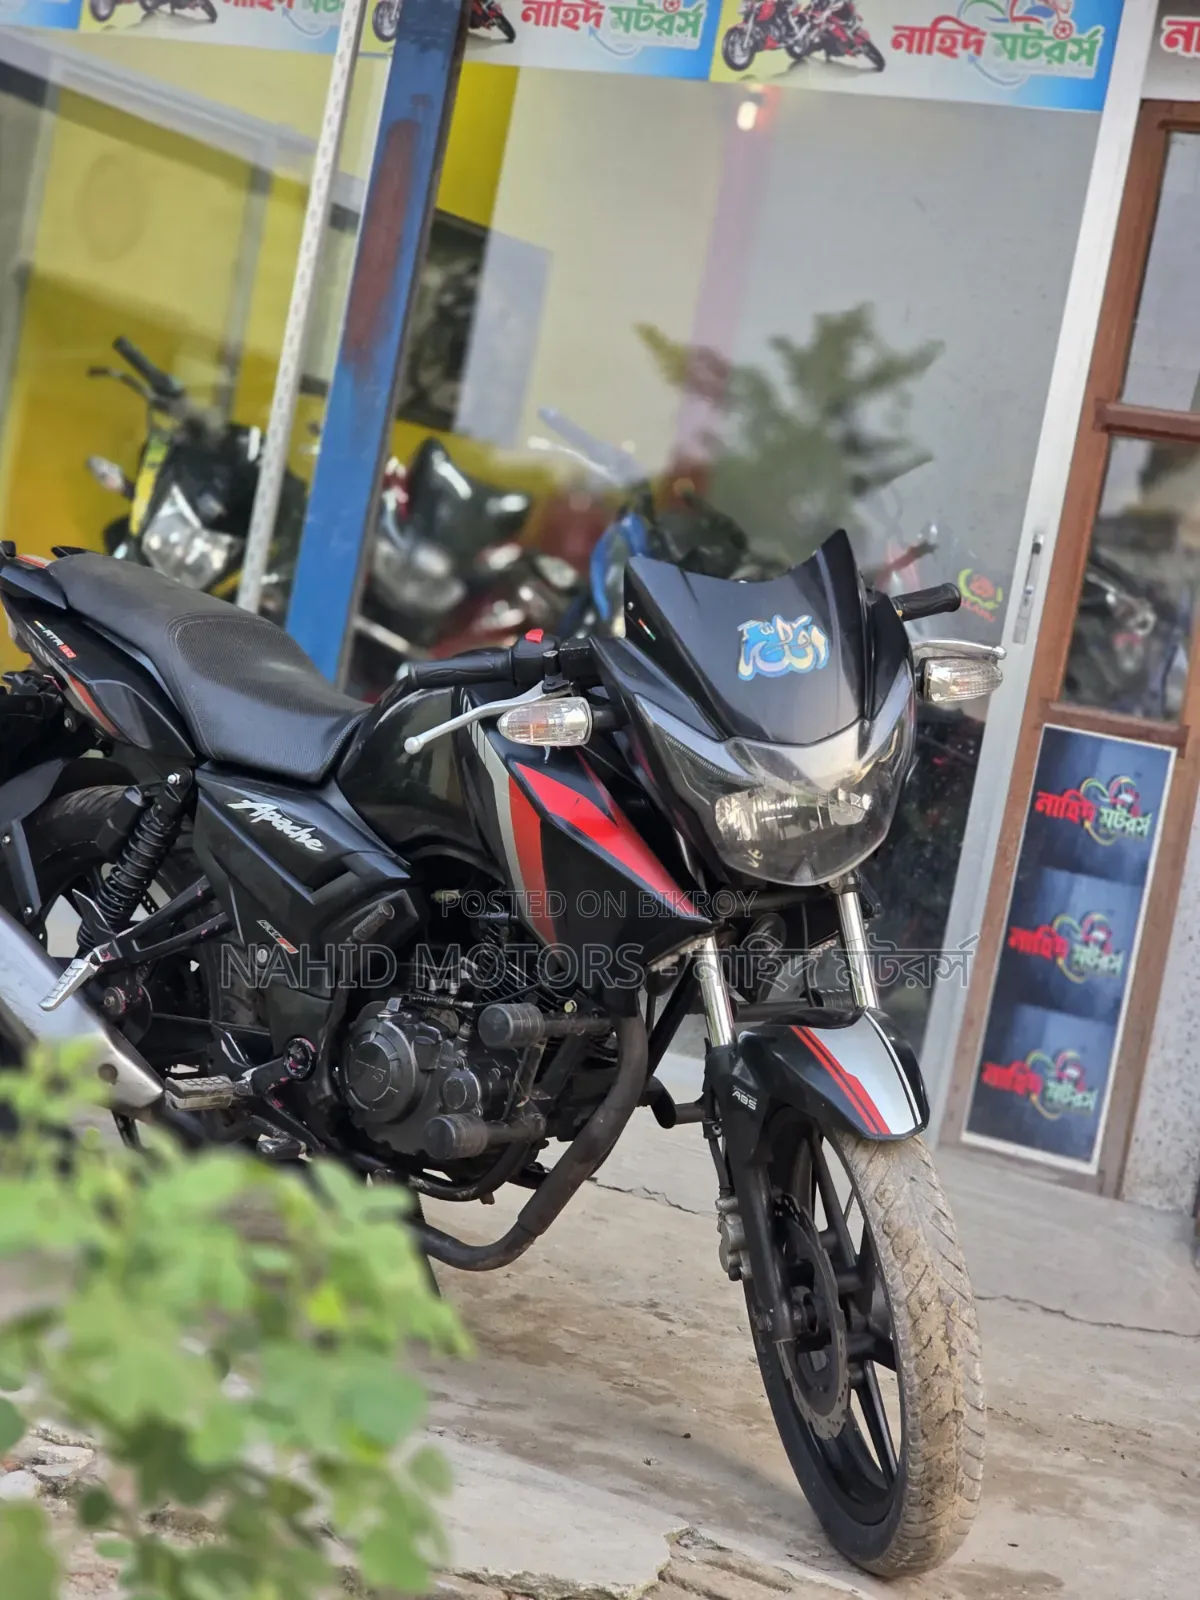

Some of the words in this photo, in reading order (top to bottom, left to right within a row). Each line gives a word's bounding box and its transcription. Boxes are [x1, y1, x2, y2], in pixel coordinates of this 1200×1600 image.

[891, 15, 988, 59] নাহিদ
[226, 799, 325, 852] Apache
[732, 1090, 757, 1110] ABS
